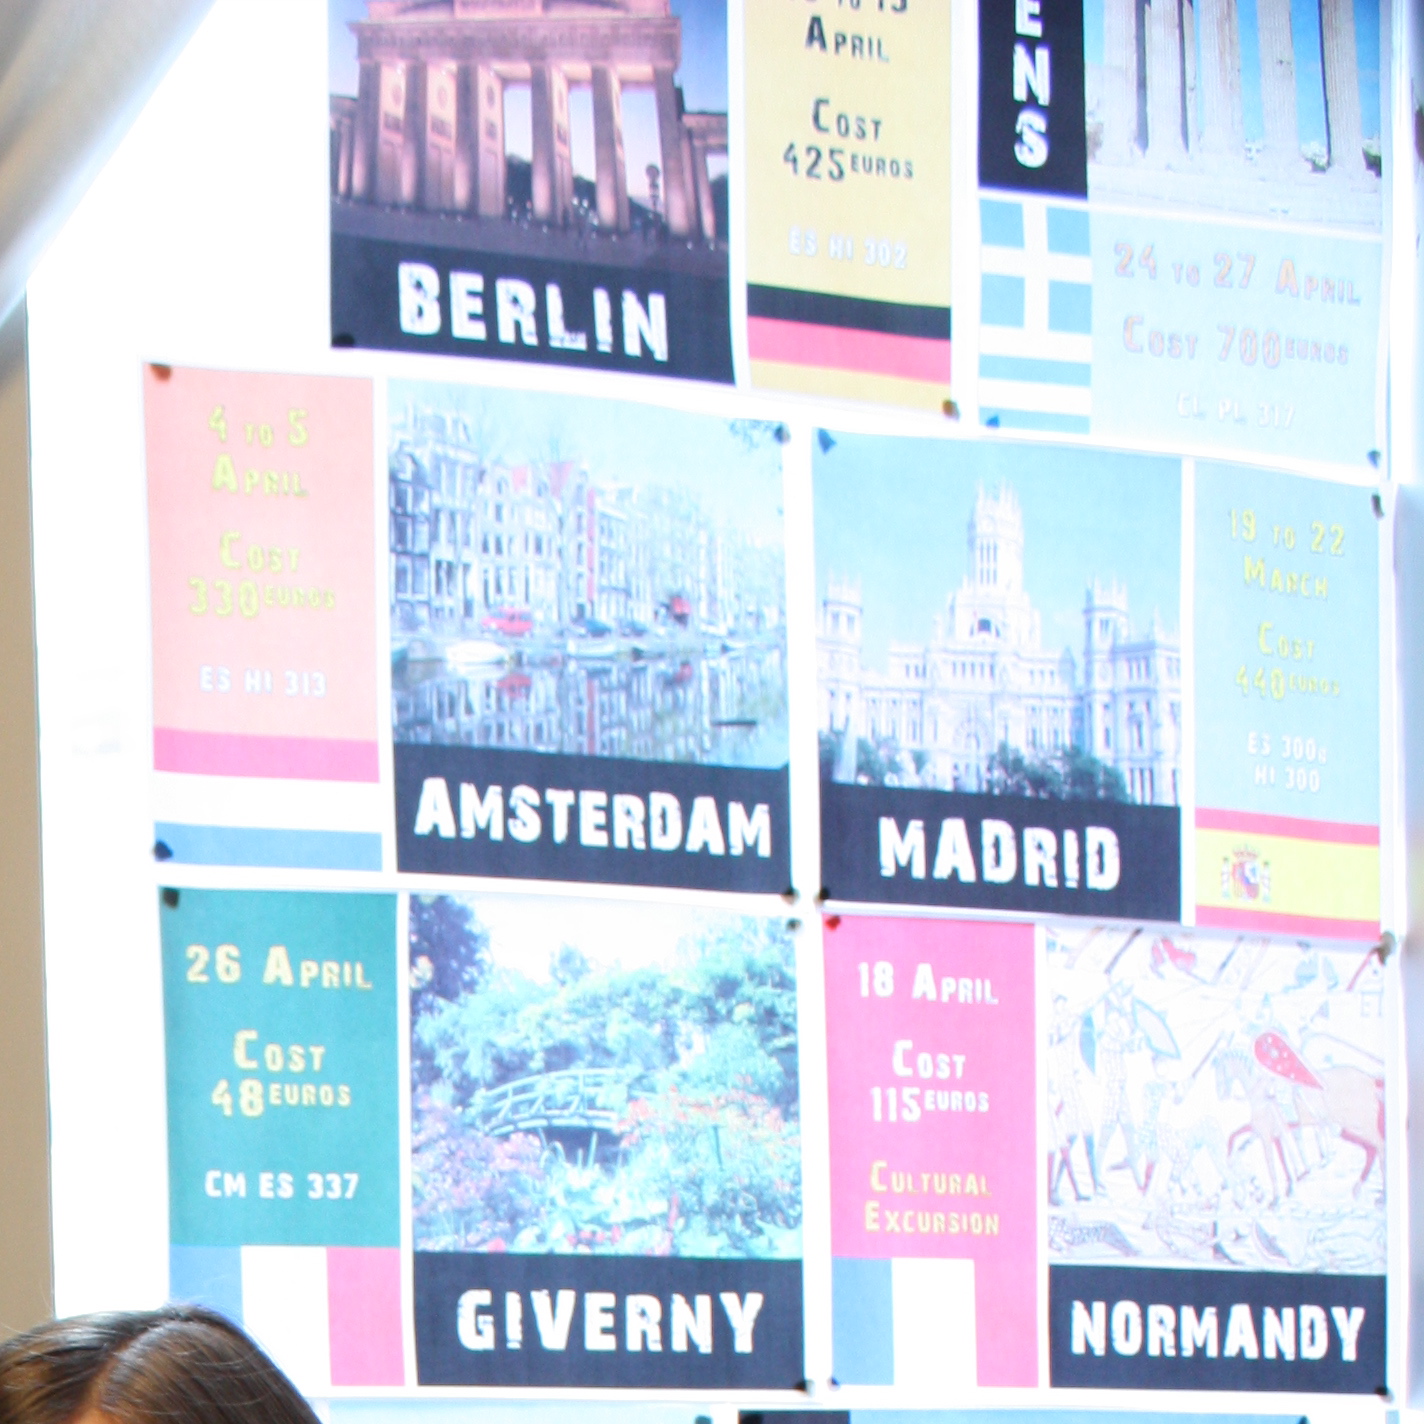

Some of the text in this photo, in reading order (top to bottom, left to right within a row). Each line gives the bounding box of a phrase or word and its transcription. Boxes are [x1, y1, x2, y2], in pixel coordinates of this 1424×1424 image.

[805, 14, 890, 64] APRIL
[812, 96, 883, 143] COST
[788, 225, 909, 270] ES HI 302
[1114, 242, 1158, 281] 24
[1213, 251, 1257, 290] 27
[1276, 256, 1362, 306] APRIL
[397, 260, 669, 363] BERLIN
[1123, 314, 1199, 361] COST
[208, 404, 228, 443] 4
[287, 407, 310, 447] 5
[211, 452, 310, 499] APRIL
[219, 529, 302, 574] COST
[1243, 554, 1329, 600] MARCH
[199, 663, 327, 699] ES HI 313
[1284, 766, 1321, 793] 300
[414, 776, 773, 859] AMSTERDAM
[878, 816, 1121, 892] MADRID
[185, 944, 373, 991] 26 APRIL
[857, 962, 999, 1005] 18 APRIL
[232, 1030, 326, 1073] COST
[892, 1039, 966, 1078] COST
[205, 1171, 360, 1201] CM ES 337
[869, 1160, 993, 1198] CULTURAL
[863, 1202, 1000, 1236] EXCURSION
[456, 1289, 763, 1355] GIVERNY
[1070, 1300, 1366, 1362] NORMANDY
